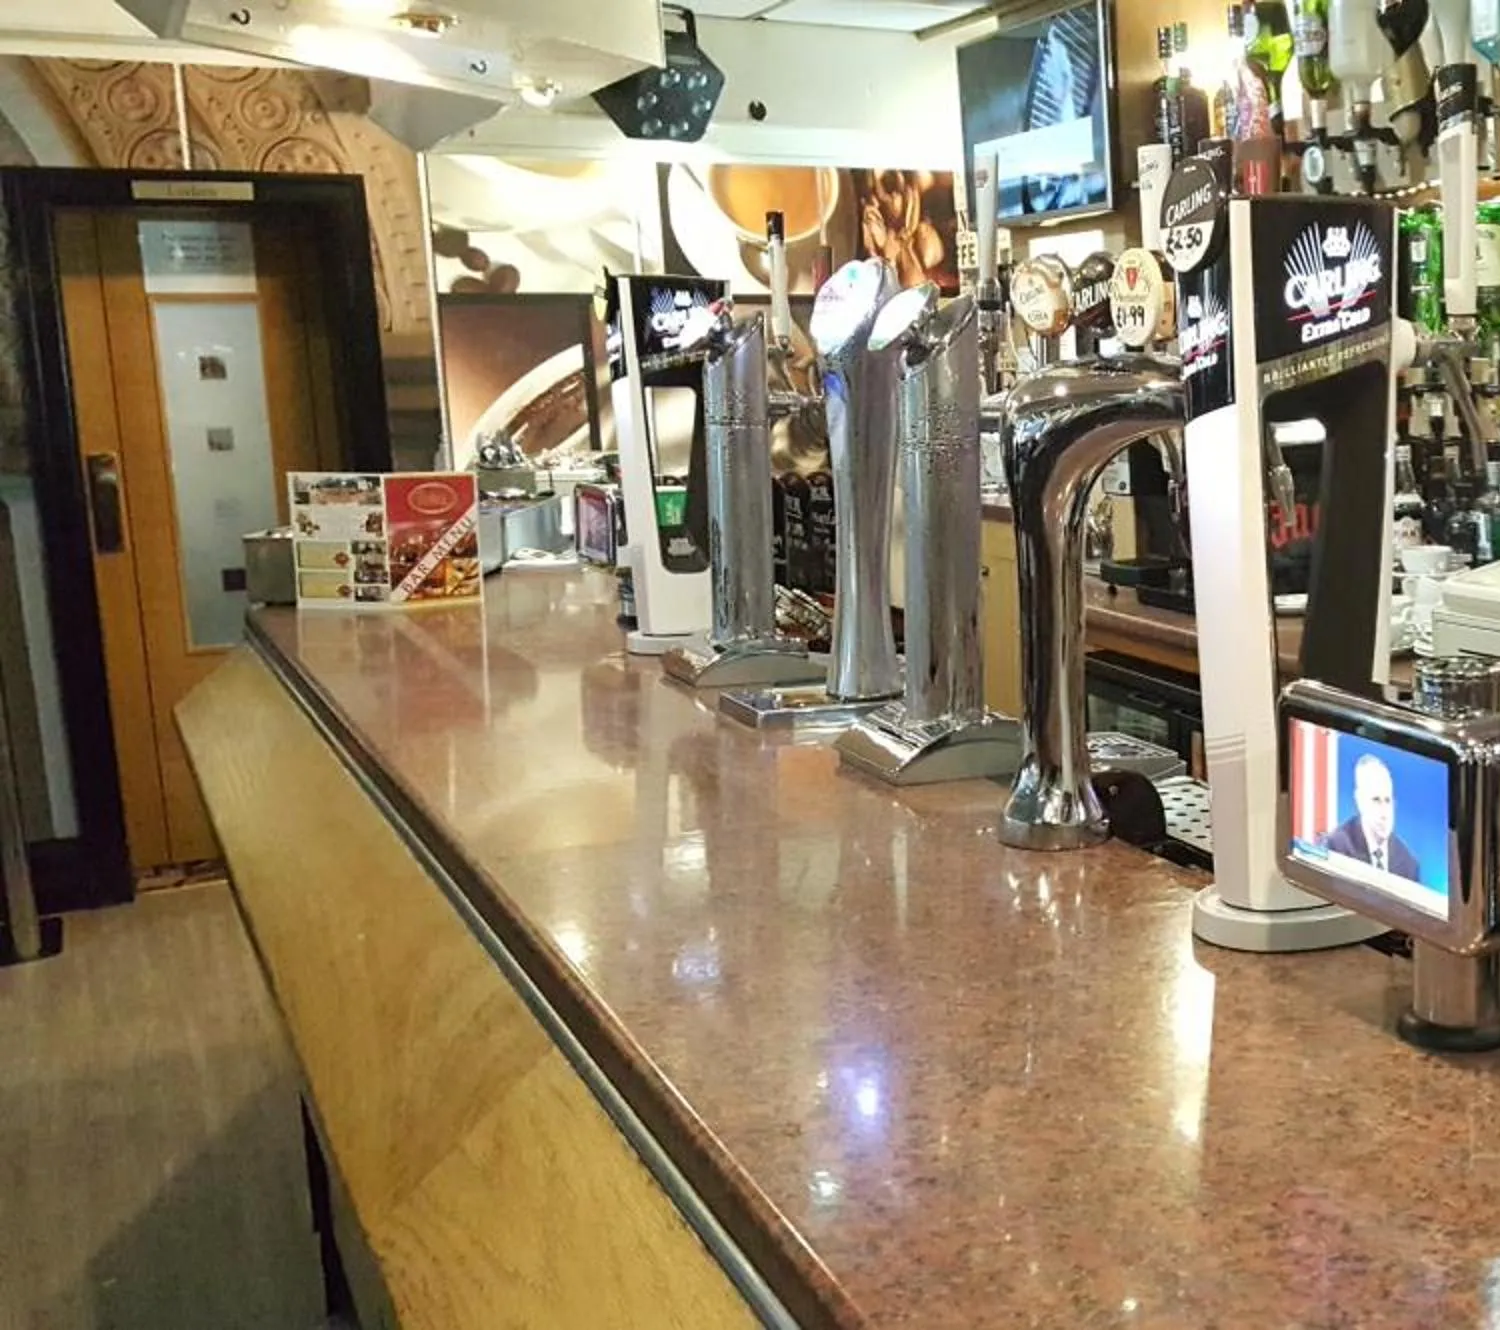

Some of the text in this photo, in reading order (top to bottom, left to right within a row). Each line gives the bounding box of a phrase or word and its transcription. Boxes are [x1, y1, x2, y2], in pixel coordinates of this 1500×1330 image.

[1164, 184, 1212, 227] CARLING
[1073, 279, 1112, 316] ARLIN
[1284, 252, 1383, 310] CARLING
[402, 562, 430, 593] BAR
[431, 515, 475, 561] MENU
